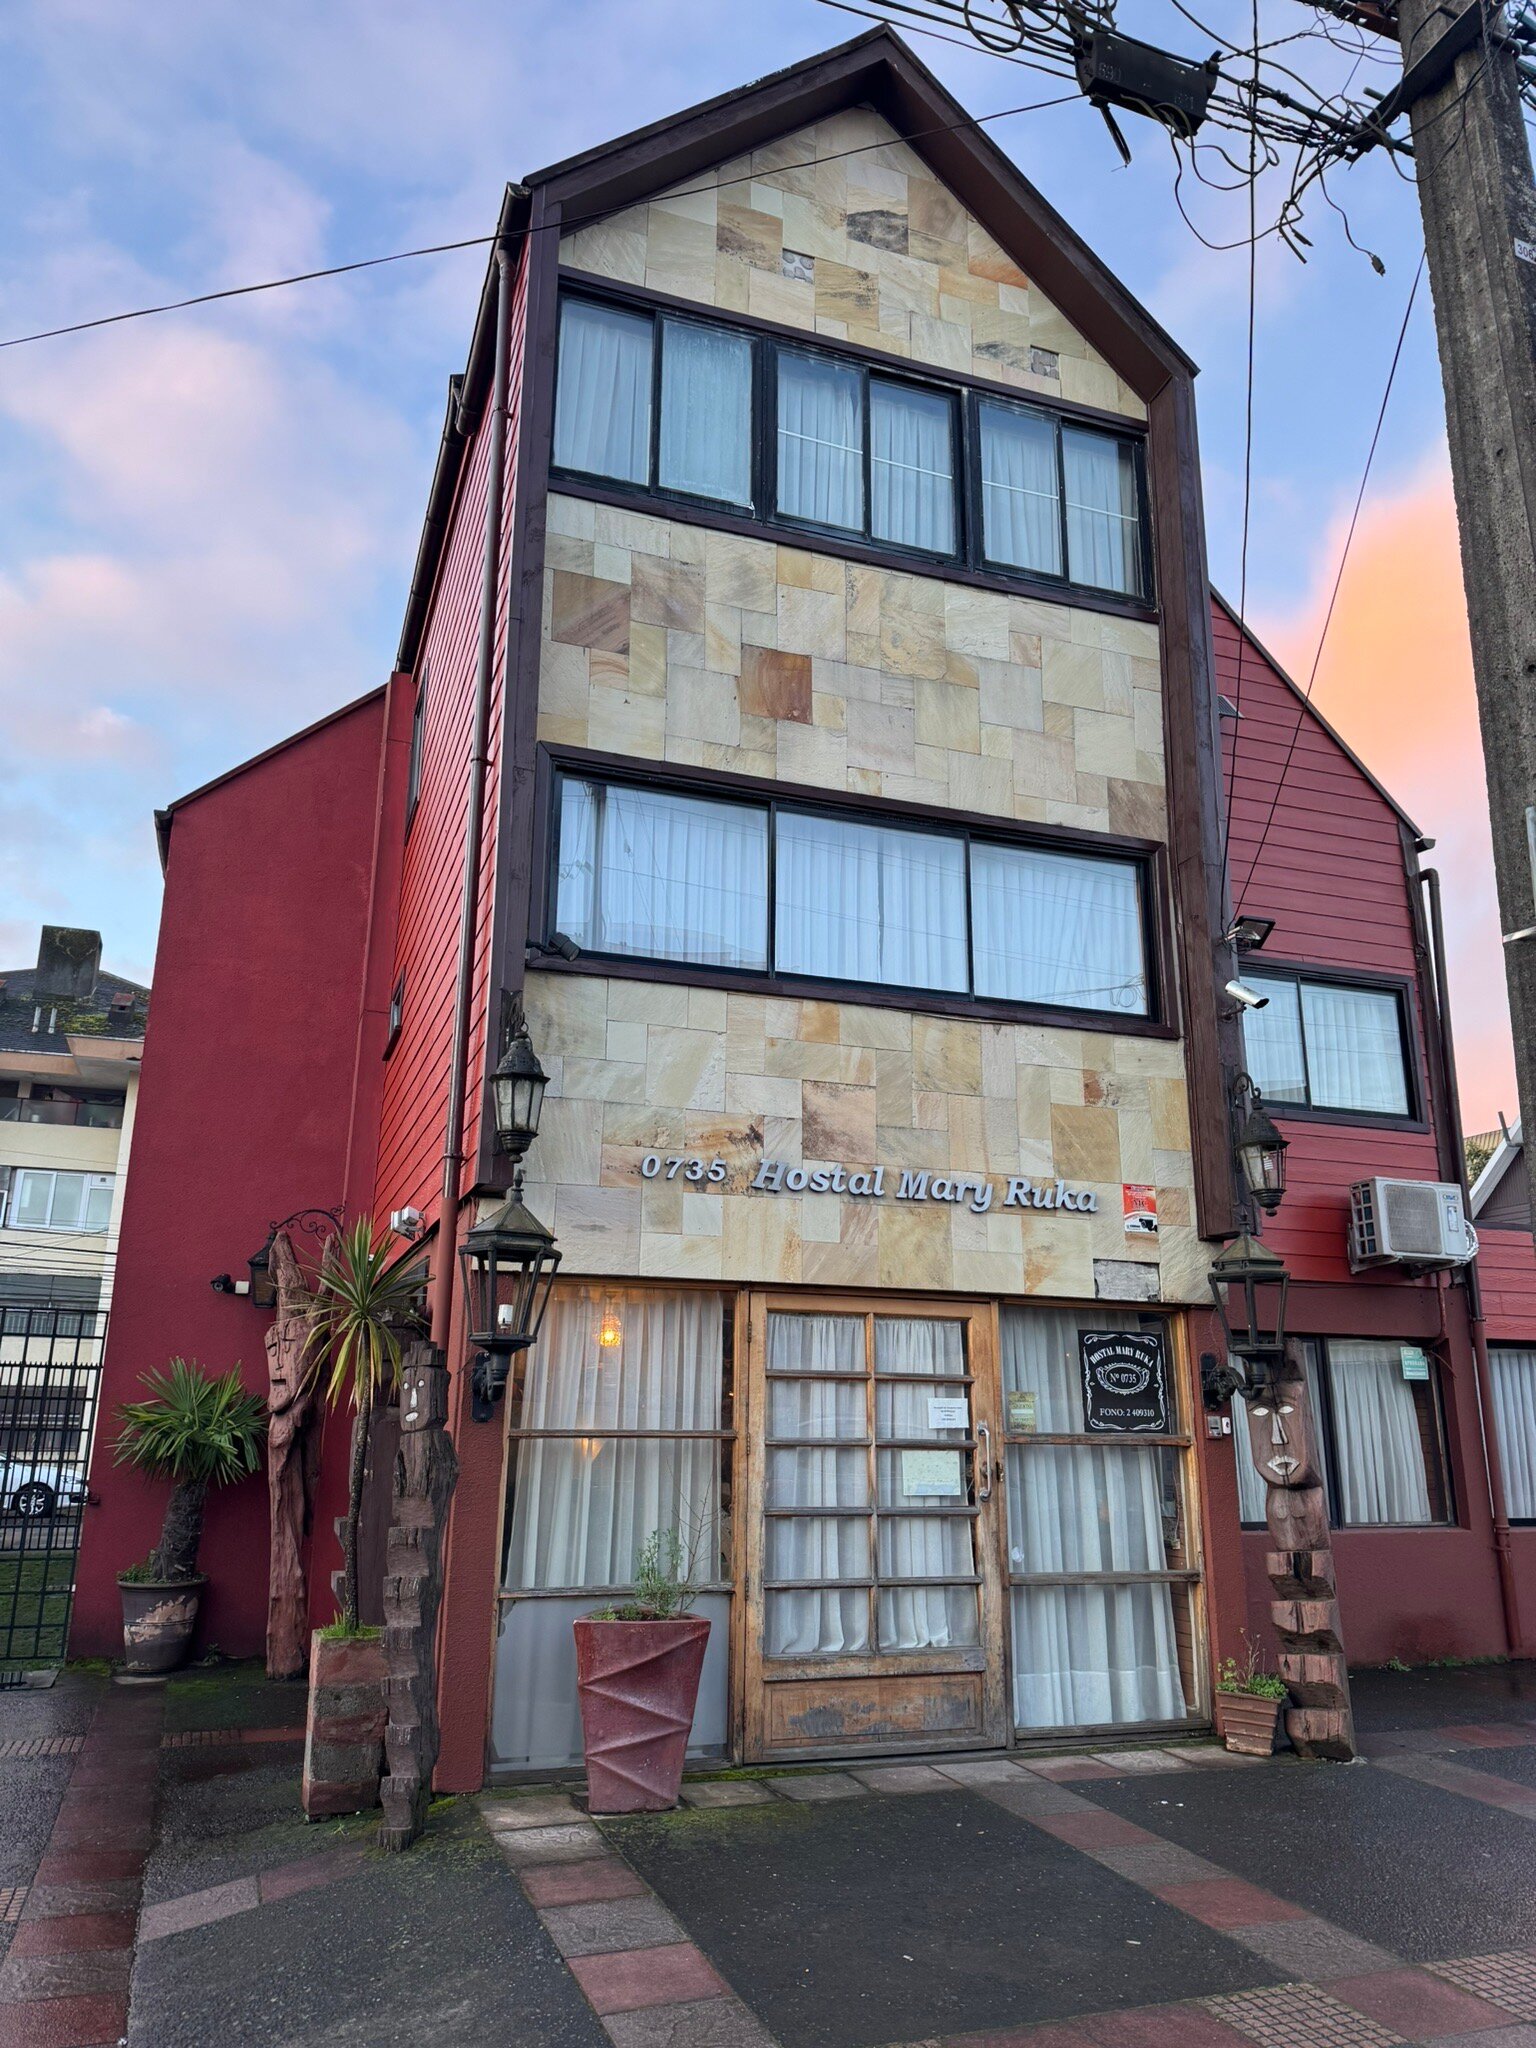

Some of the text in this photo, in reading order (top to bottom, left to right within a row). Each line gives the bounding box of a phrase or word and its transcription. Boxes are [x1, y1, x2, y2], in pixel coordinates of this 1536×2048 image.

[641, 1154, 1100, 1214] 0735 Hostal Mary Ruka
[1090, 1346, 1154, 1368] HOSTAL MARY RUKA
[1120, 1373, 1137, 1383] 0735
[1099, 1407, 1155, 1417] FONO: 2 409310
